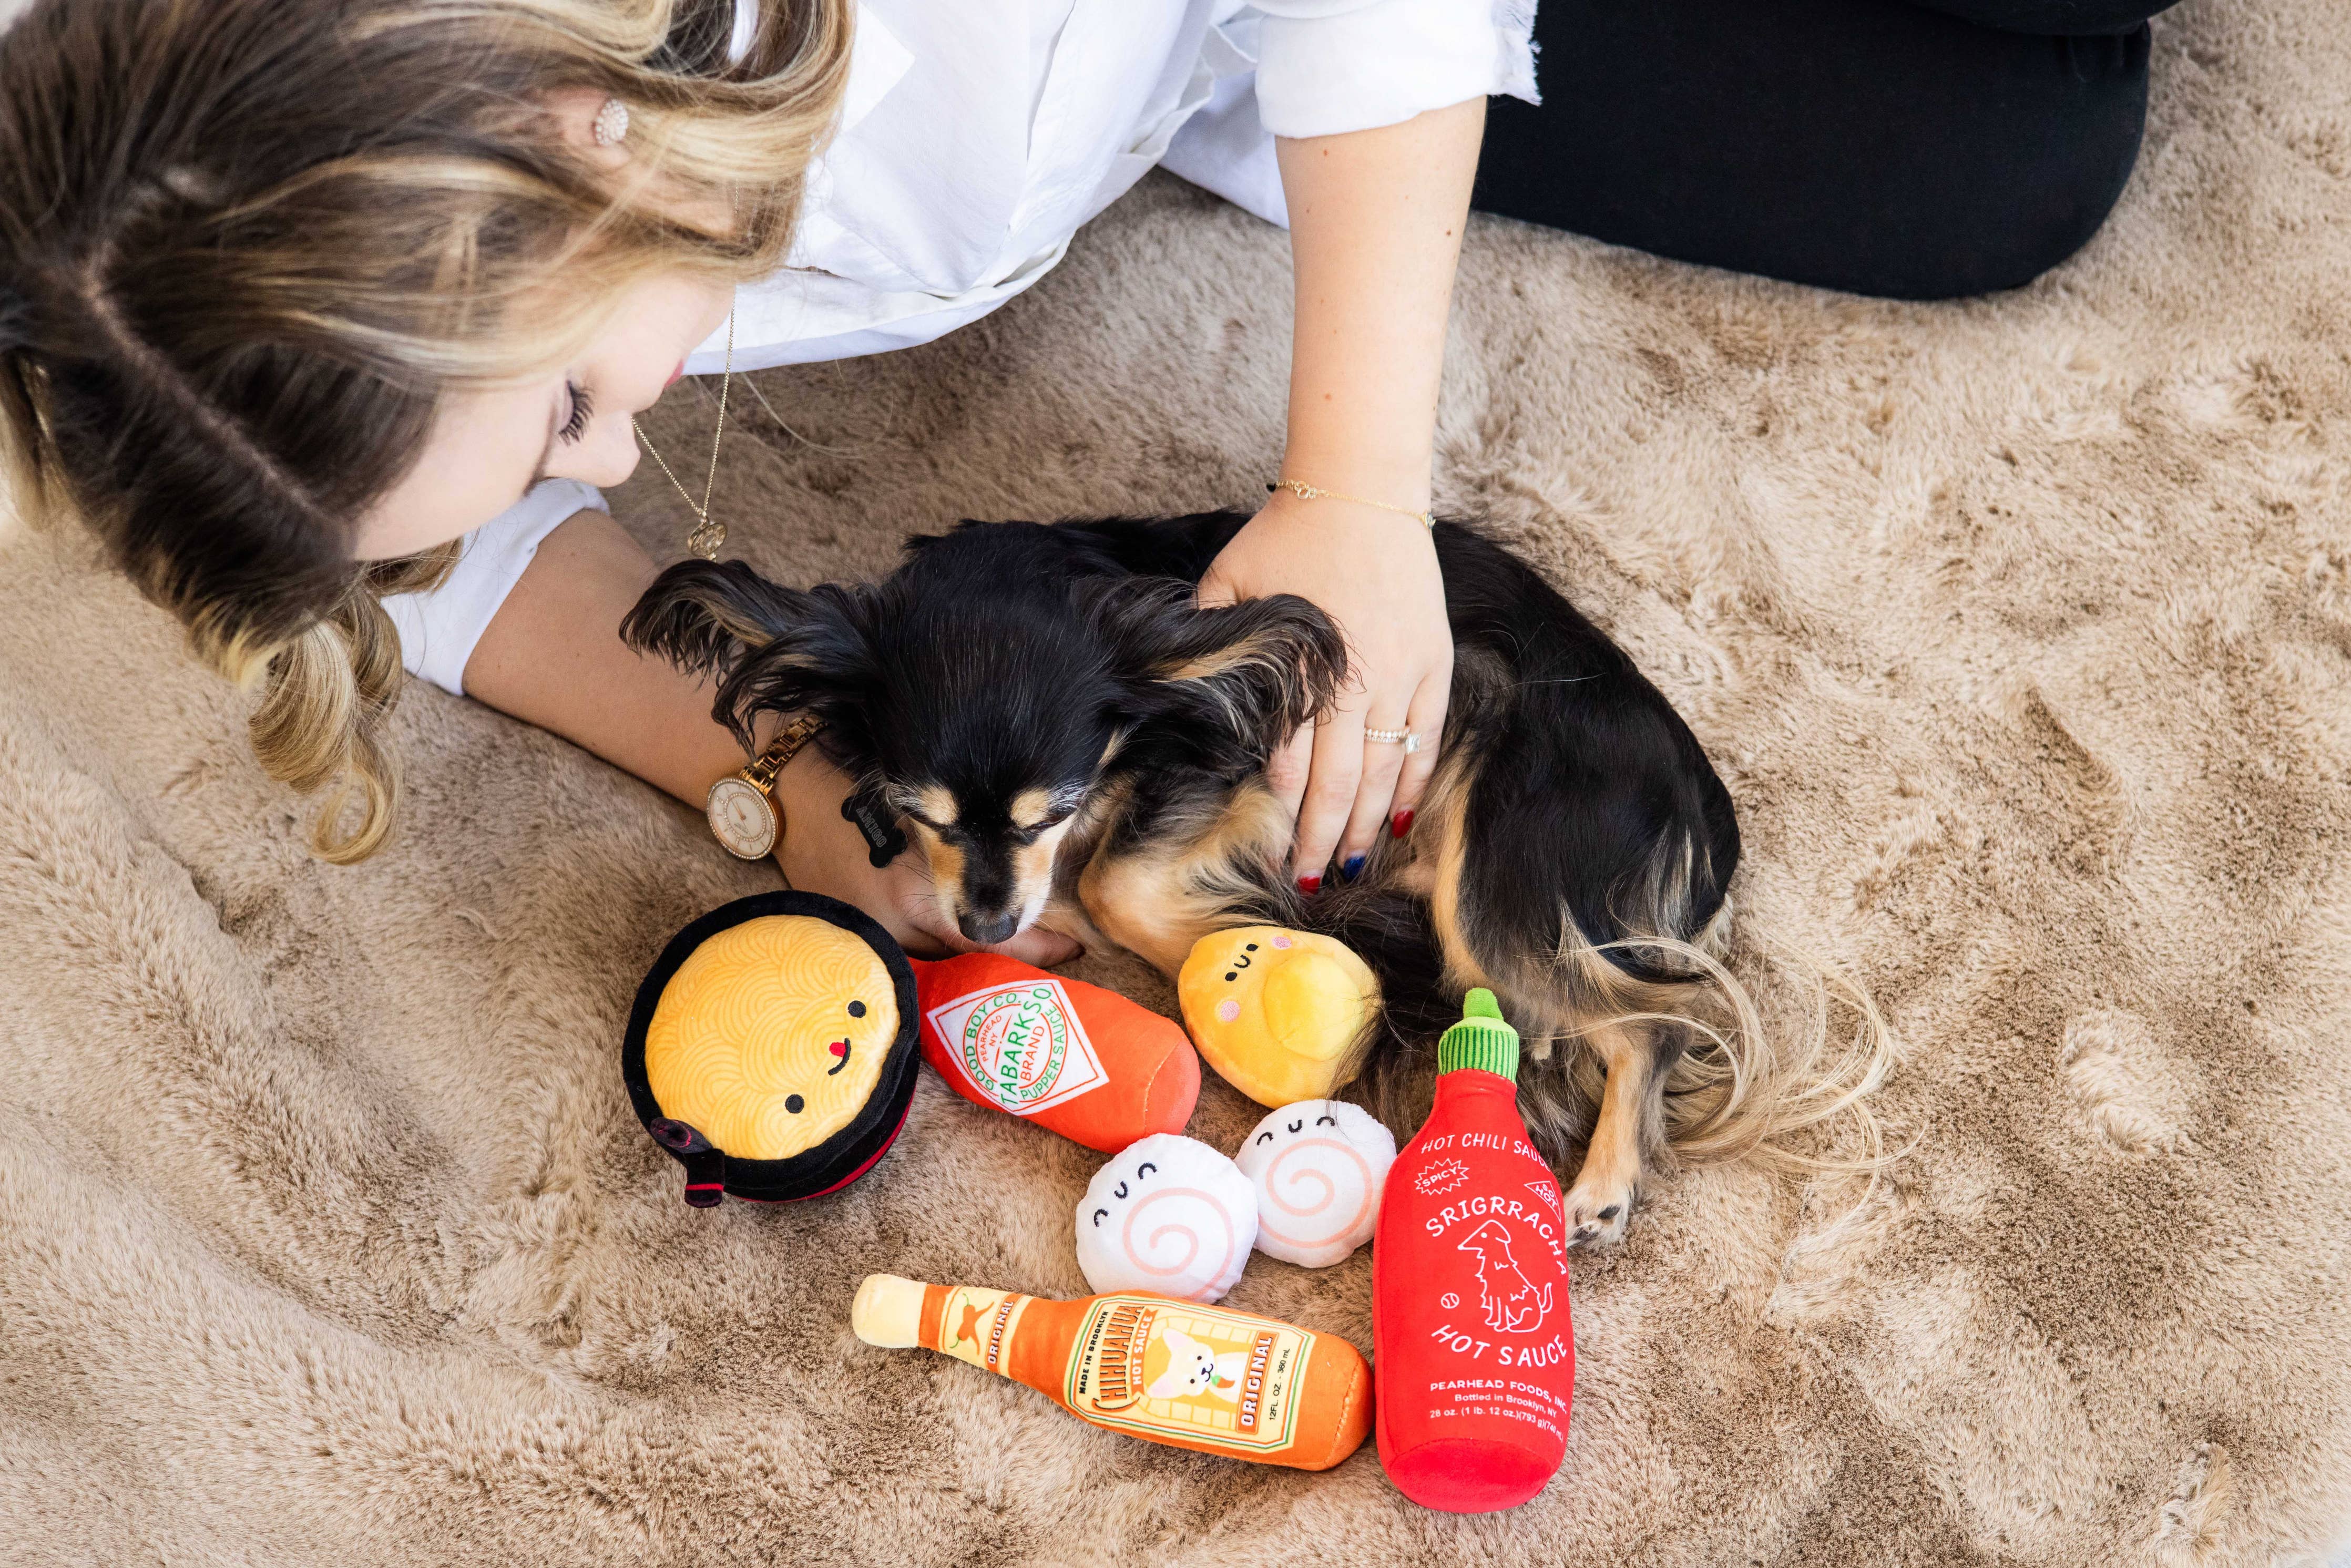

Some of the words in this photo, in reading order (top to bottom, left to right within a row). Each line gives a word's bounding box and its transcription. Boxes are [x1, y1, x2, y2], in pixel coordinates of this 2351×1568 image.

[856, 806, 887, 847] AMIGO
[994, 992, 1021, 1007] CO.
[966, 1004, 989, 1039] BOY
[979, 1014, 1002, 1062] PEARHEAD
[988, 1034, 998, 1047] NY
[1000, 988, 1052, 1104] TABARKSO
[1020, 1025, 1045, 1081] BRAND
[1020, 1059, 1060, 1100] PUPPER
[1045, 1006, 1066, 1055] SAUCE
[966, 1046, 995, 1091] GOOD
[1420, 1134, 1455, 1154] HOT
[1461, 1133, 1507, 1150] CHILI
[1422, 1166, 1458, 1187] SPICY
[1535, 1185, 1557, 1207] HOT
[1542, 1184, 1555, 1197] SO
[1426, 1196, 1568, 1275] SRIGRRACHA
[988, 1301, 1015, 1365] ORIGINAL
[1088, 1311, 1109, 1351] BROOKLYN
[1134, 1316, 1152, 1353] SAUCE
[1283, 1348, 1290, 1359] mL
[1430, 1324, 1490, 1359] HOT
[1498, 1334, 1568, 1368] SAUCE
[1085, 1355, 1092, 1365] IN
[1091, 1306, 1144, 1413] CHIHUAHUA
[1132, 1358, 1142, 1385] HOT
[1277, 1360, 1286, 1374] 360
[1079, 1368, 1089, 1394] MADE
[1241, 1336, 1273, 1427] ORIGINAL
[1273, 1382, 1282, 1396] OZ.
[1430, 1379, 1505, 1391] PEARHEAD
[1510, 1380, 1552, 1403] FOODS,
[1270, 1400, 1279, 1420] 12FL.
[1455, 1393, 1491, 1402] Bottled
[1506, 1394, 1546, 1415] Brooklyn,
[1547, 1407, 1557, 1418] NY
[1461, 1407, 1470, 1417] (1
